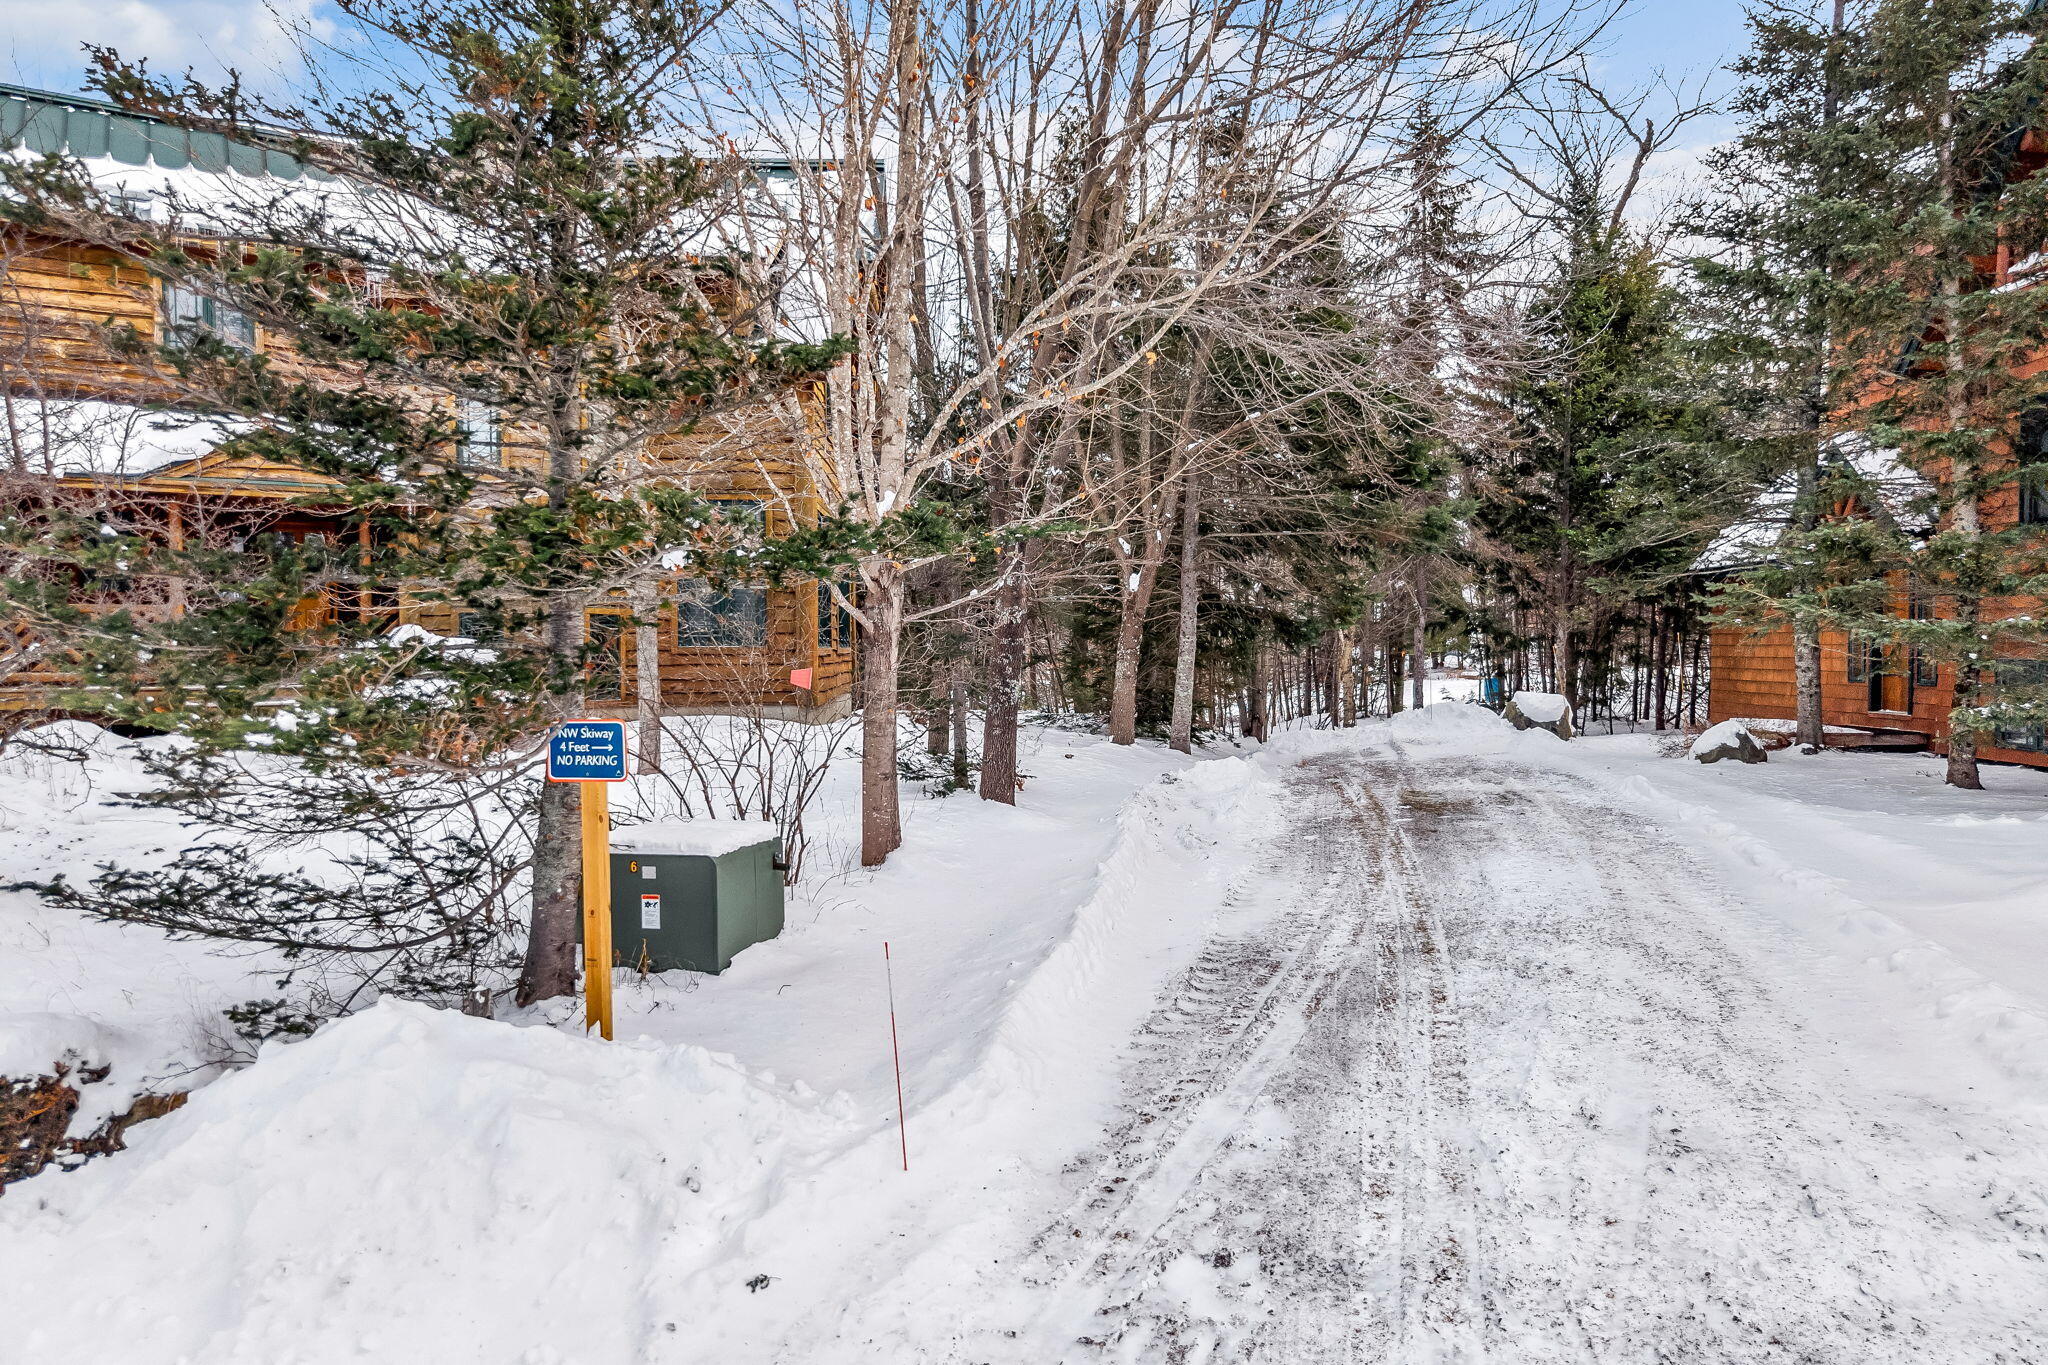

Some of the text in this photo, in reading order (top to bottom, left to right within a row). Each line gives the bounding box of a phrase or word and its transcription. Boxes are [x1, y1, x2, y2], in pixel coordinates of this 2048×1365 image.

[558, 727, 614, 741] NW Skiway
[560, 742, 590, 752] 4 Feet
[557, 755, 618, 766] NO PARKING
[630, 861, 637, 872] 6
